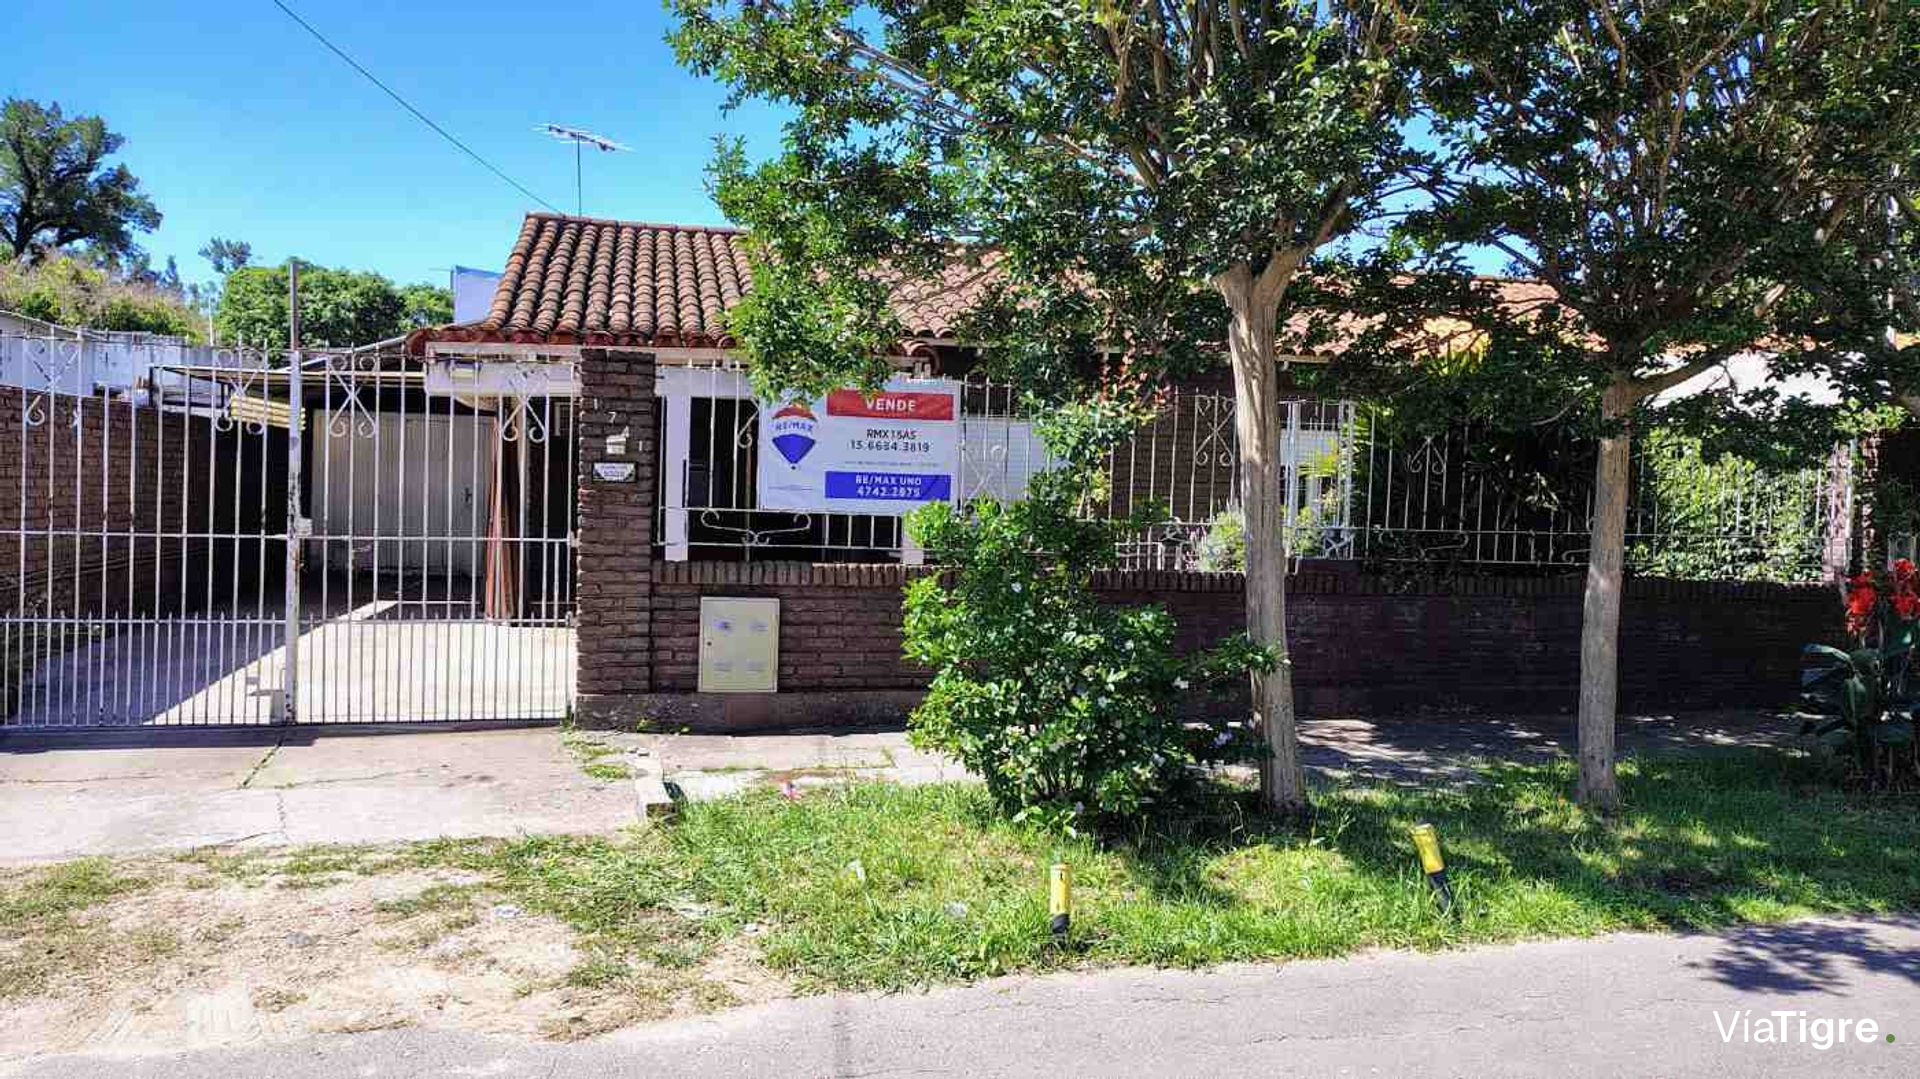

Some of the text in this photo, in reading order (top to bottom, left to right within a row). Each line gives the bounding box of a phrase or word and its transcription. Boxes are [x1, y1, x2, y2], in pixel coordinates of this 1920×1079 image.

[865, 397, 917, 412] VENDE
[775, 421, 814, 432] RE/MAX
[855, 474, 922, 486] RE/MAX UNO
